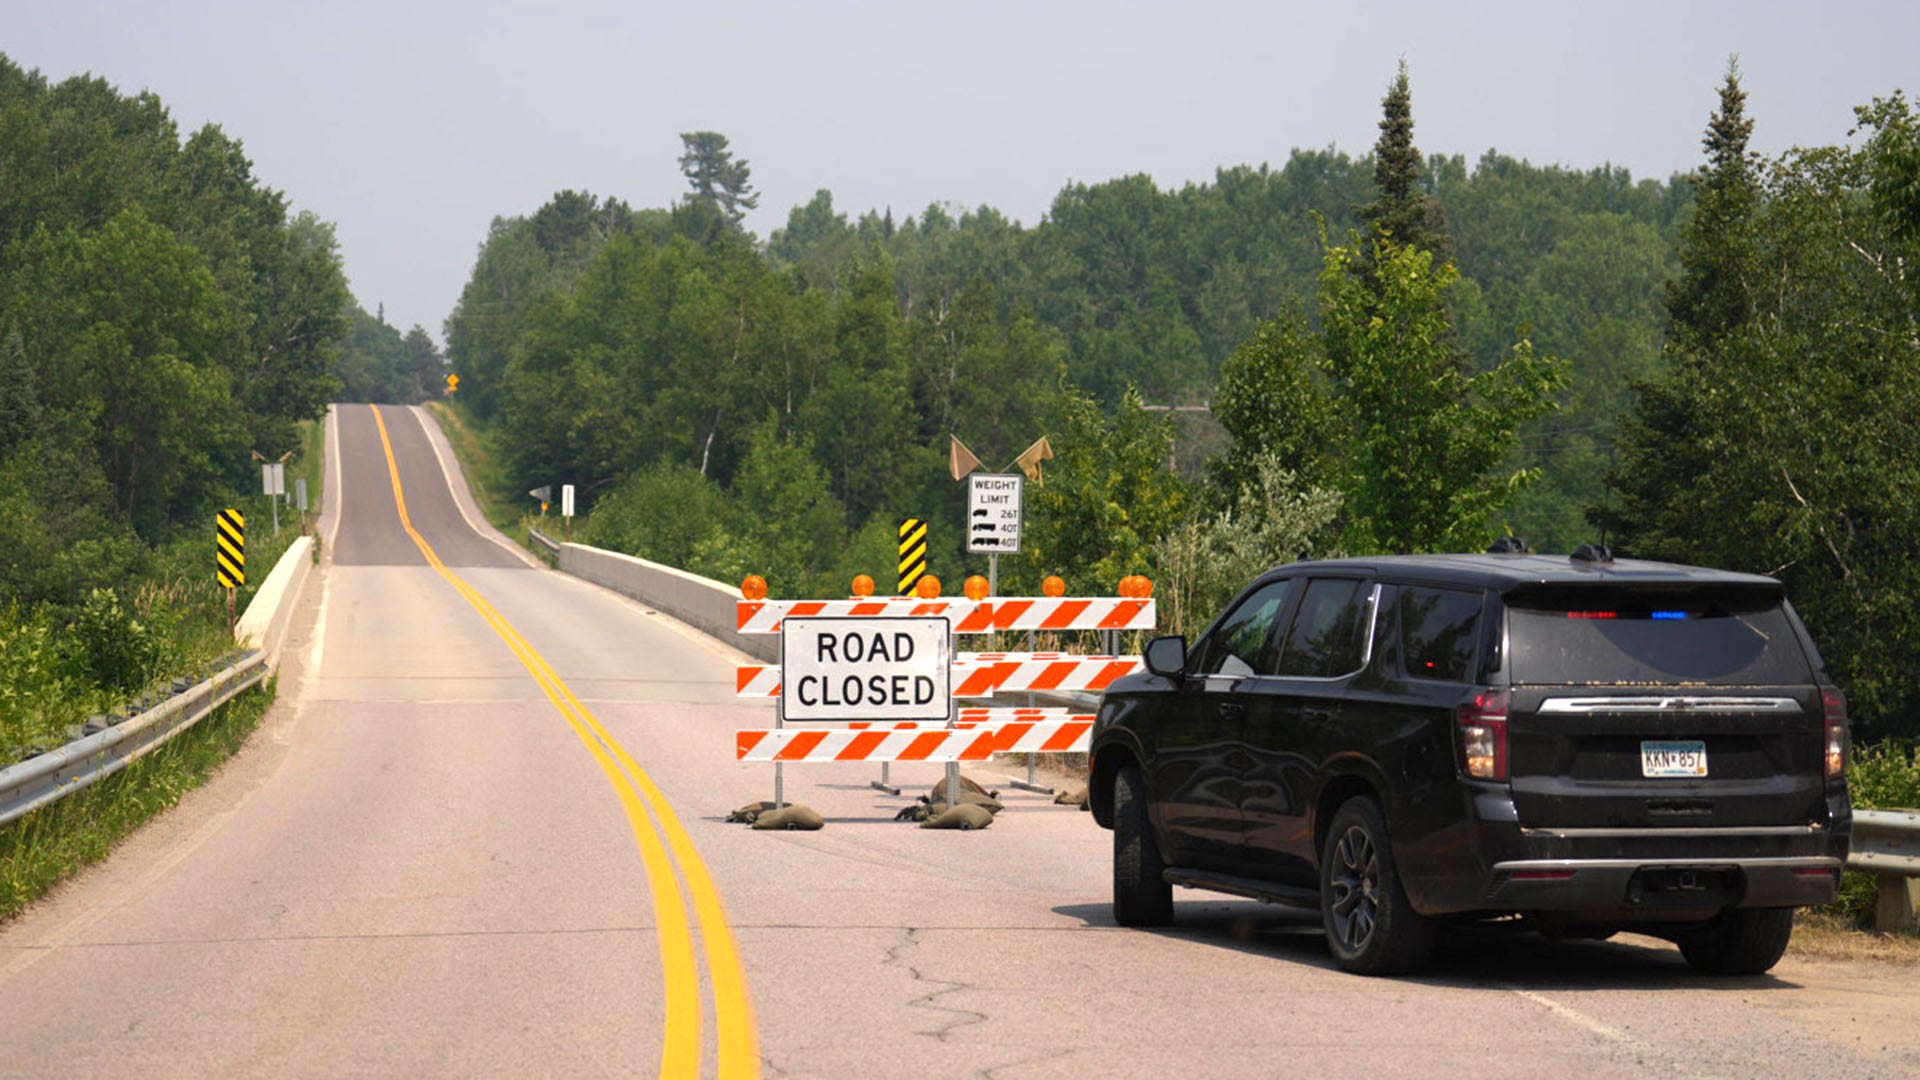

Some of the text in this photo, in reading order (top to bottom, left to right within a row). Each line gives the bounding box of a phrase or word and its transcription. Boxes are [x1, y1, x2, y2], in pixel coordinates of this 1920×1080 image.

[975, 481, 1016, 490] WEIGHT
[981, 496, 1009, 504] LIMIT
[1001, 510, 1017, 518] 26T
[818, 632, 914, 662] ROAD
[798, 676, 934, 706] CLOSED
